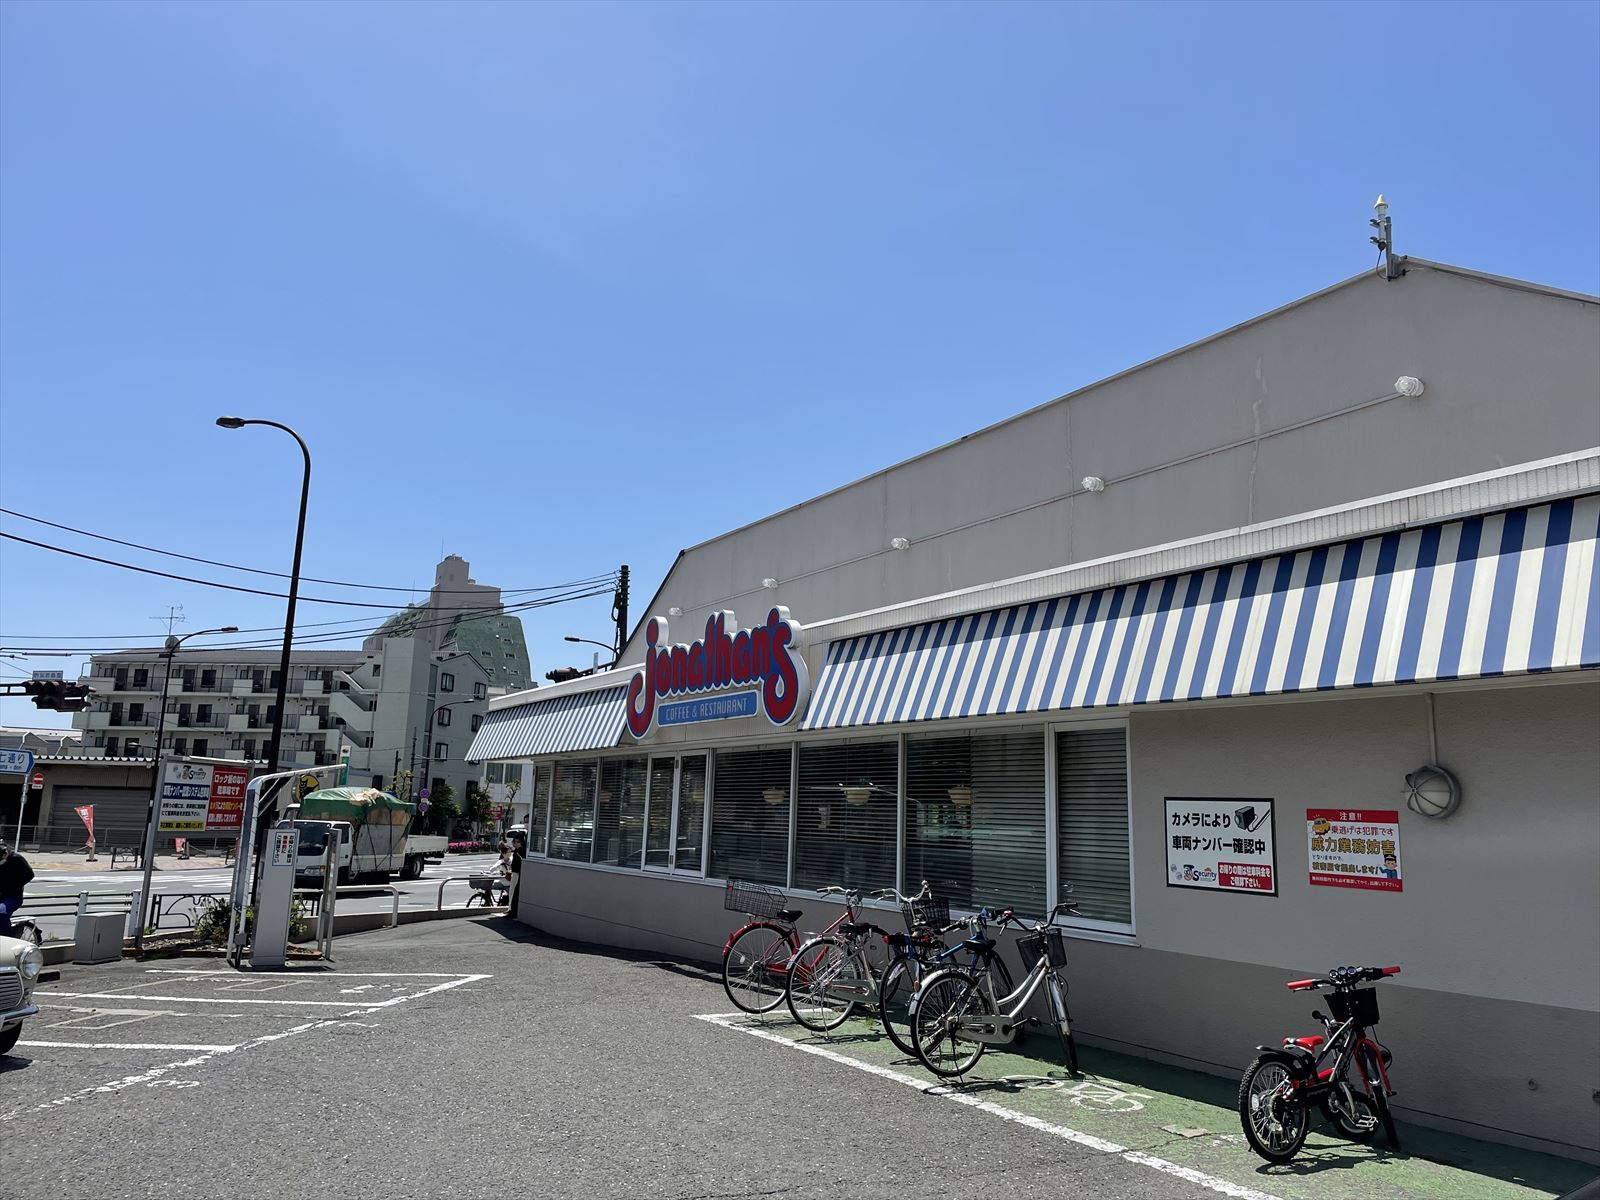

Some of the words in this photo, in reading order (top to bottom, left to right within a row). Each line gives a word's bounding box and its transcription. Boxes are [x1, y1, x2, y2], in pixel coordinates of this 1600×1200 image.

[666, 706, 690, 721] COFFEE
[691, 705, 697, 718] &
[700, 697, 748, 716] RESTAURANT
[1172, 812, 1231, 828] カメラにより
[1172, 834, 1266, 855] 車両ナンバー確認中
